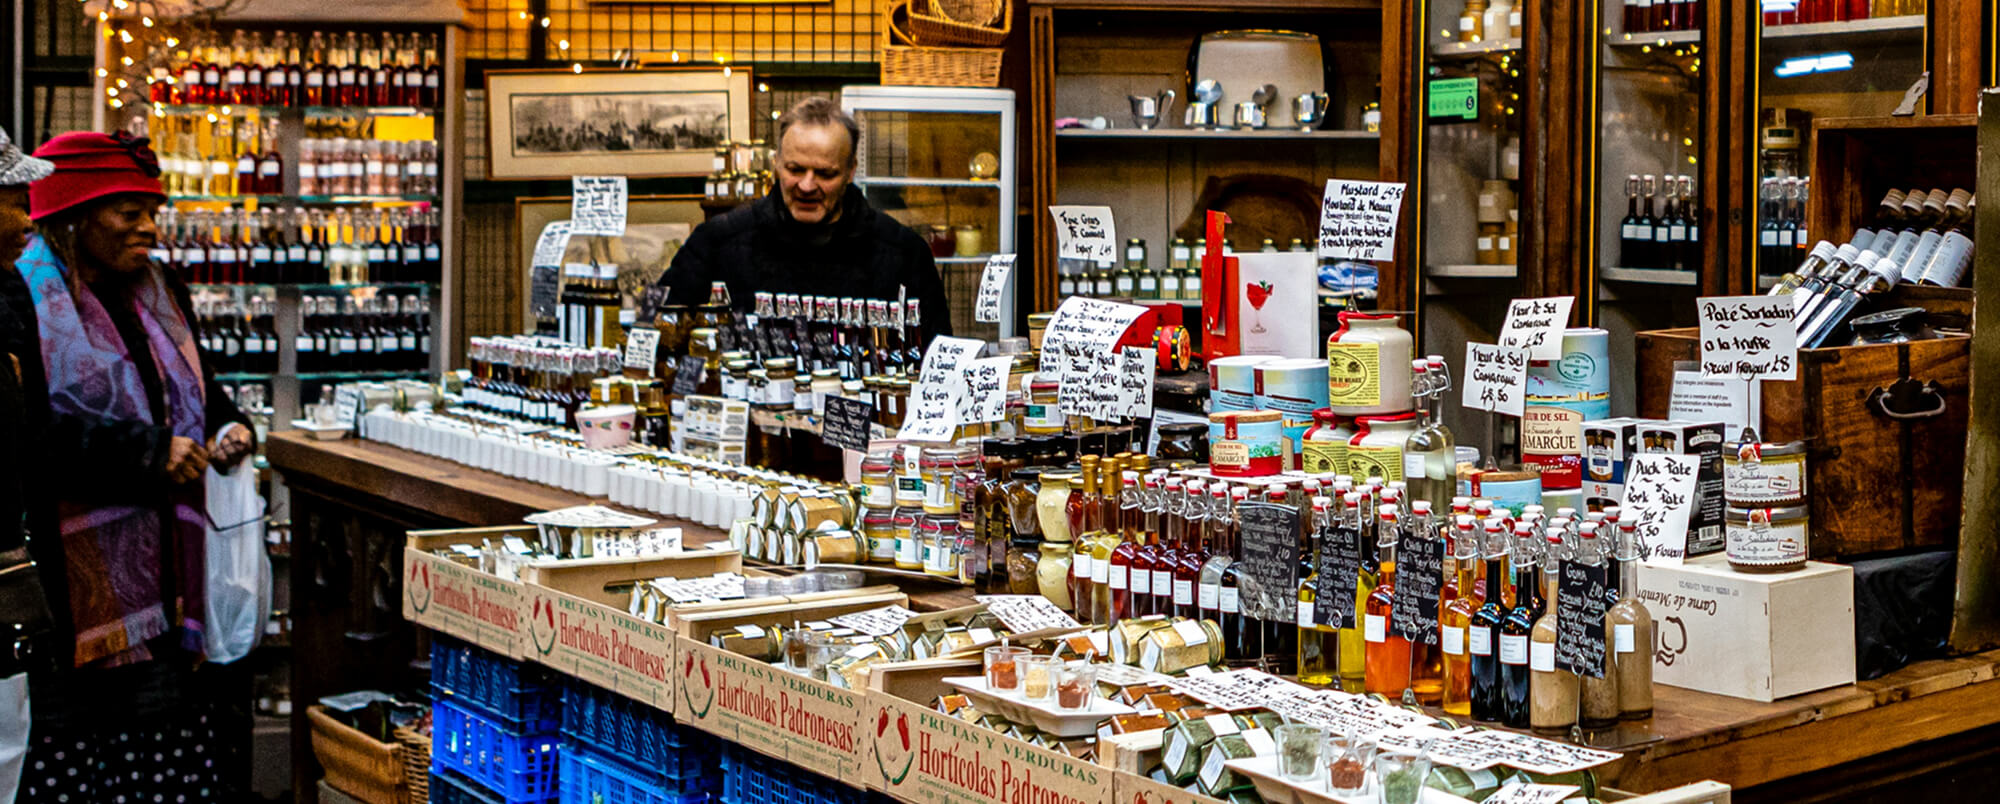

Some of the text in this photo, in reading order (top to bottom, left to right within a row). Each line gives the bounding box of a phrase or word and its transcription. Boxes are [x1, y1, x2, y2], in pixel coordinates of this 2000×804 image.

[1717, 337, 1730, 350] la
[1770, 354, 1790, 374] £8
[1540, 413, 1552, 421] DE
[1554, 413, 1570, 421] SEL
[1523, 435, 1576, 449] AMARGUE
[558, 597, 599, 619] FRUTAS
[611, 614, 665, 642] VERDURAS
[1636, 589, 1717, 616] Carne de Membr
[560, 611, 665, 682] Hortícolas Padronesas
[717, 654, 854, 709] FRUTAS Y VERDURAS
[717, 670, 854, 753] Hortícolas Padronesas
[918, 730, 1086, 804] Hortícolas Padron
[919, 712, 1098, 785] FRUTAS Y VERDURAS
